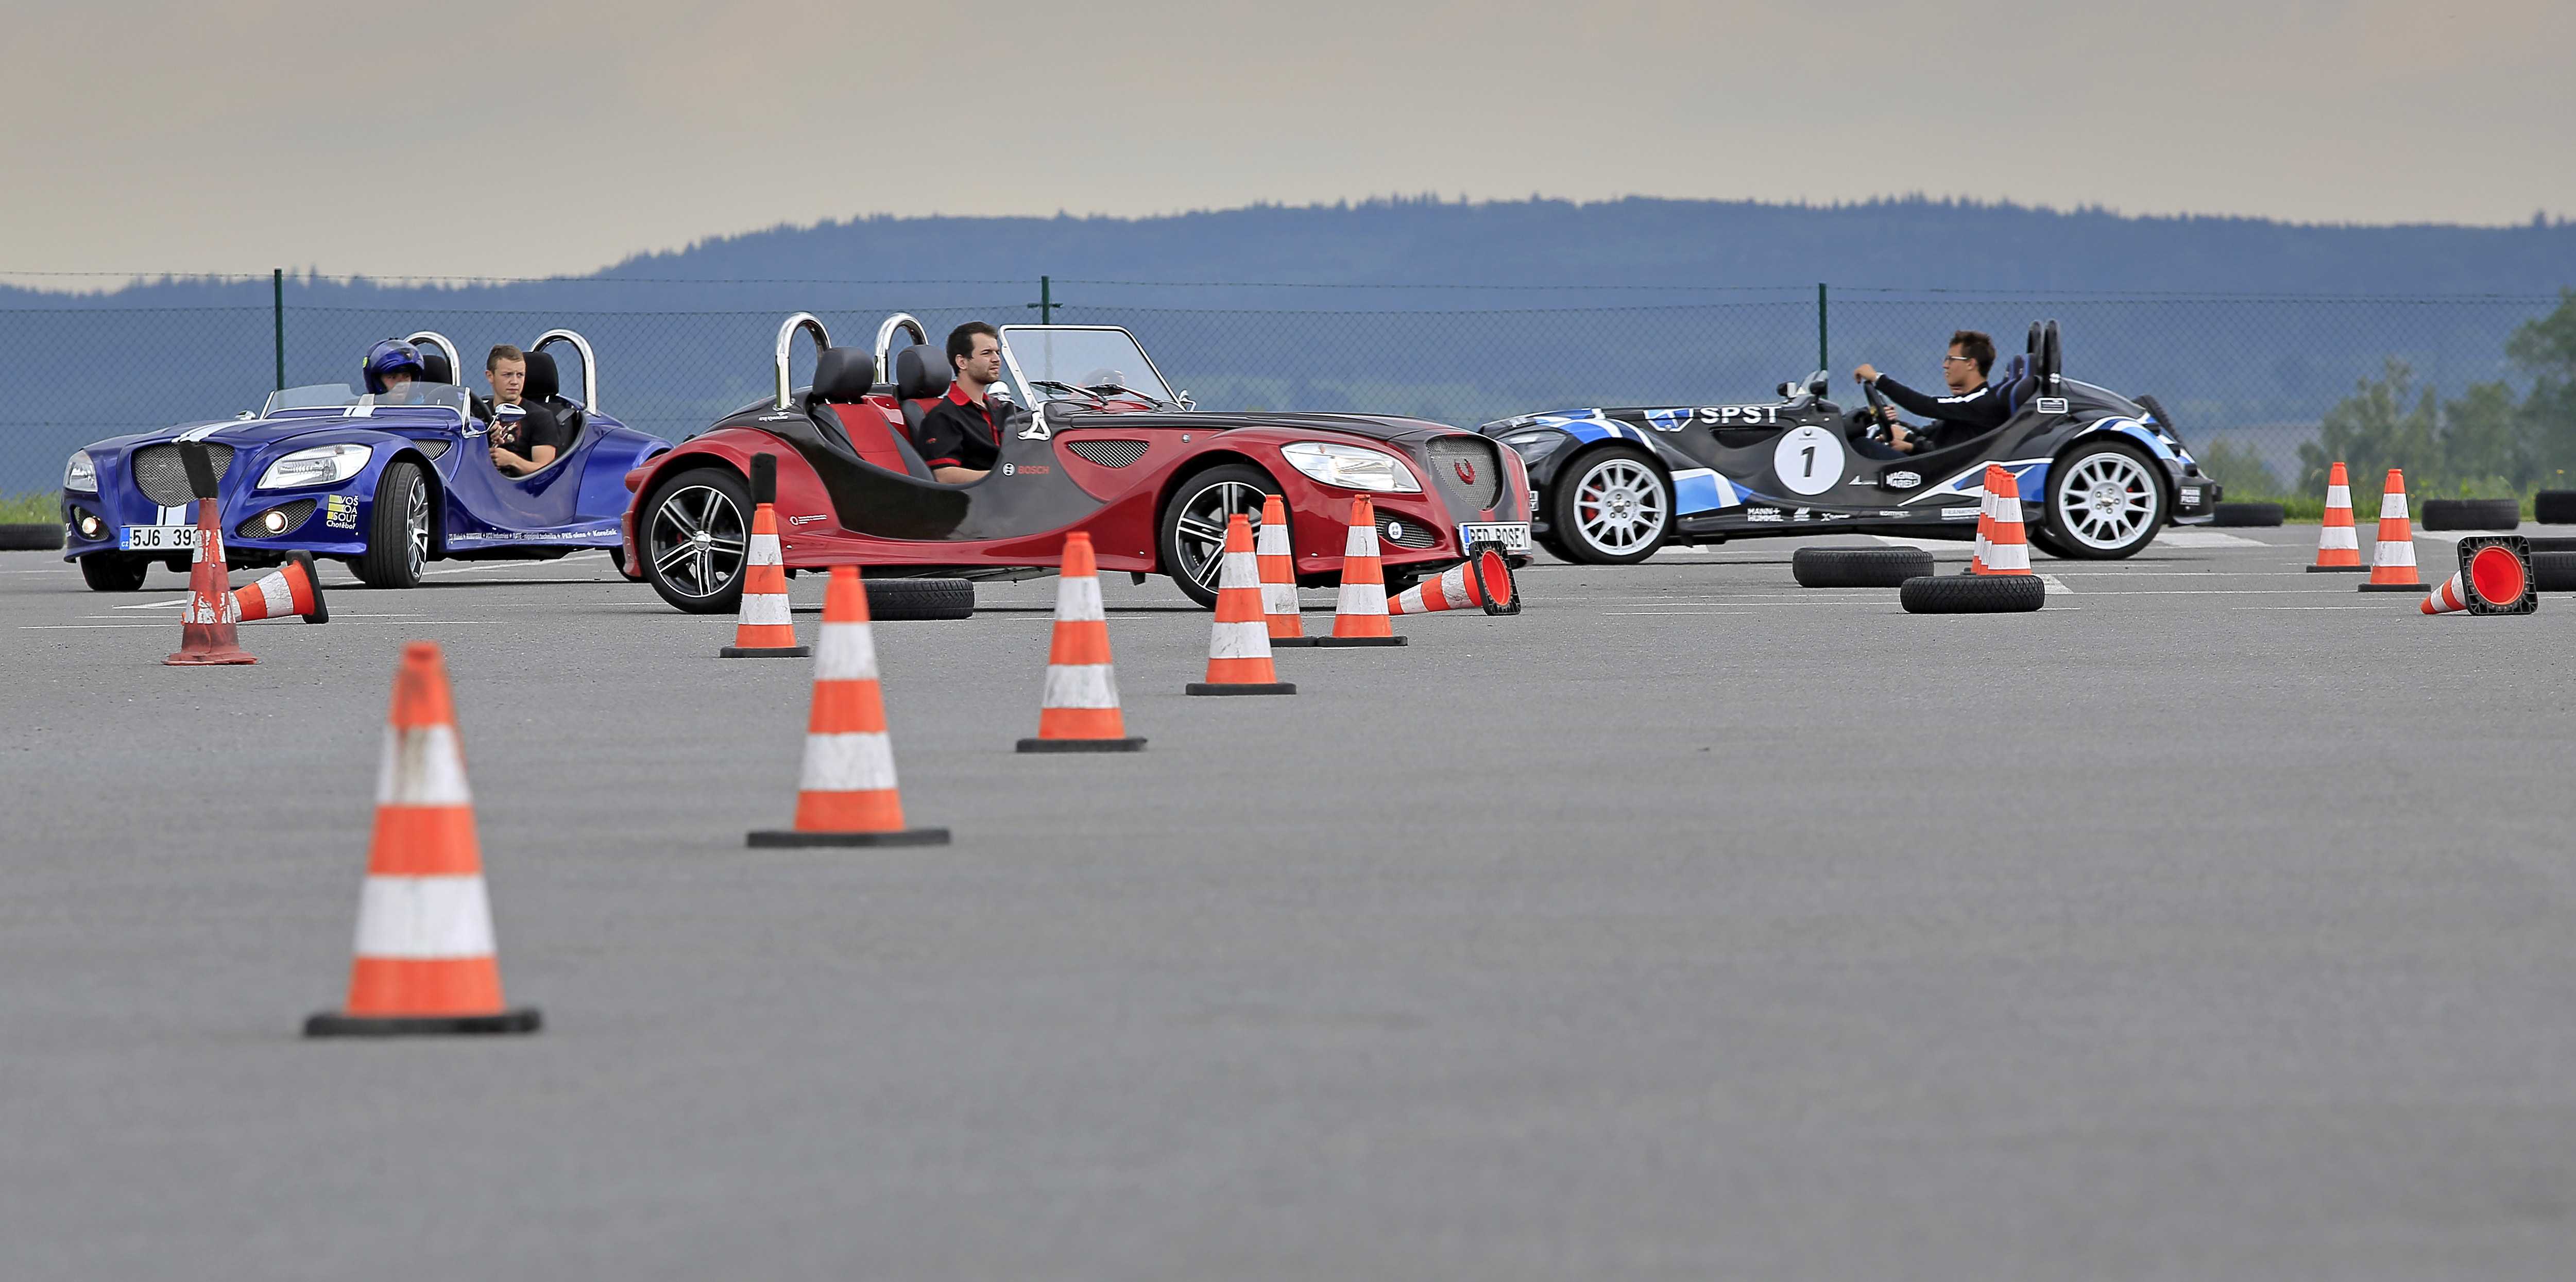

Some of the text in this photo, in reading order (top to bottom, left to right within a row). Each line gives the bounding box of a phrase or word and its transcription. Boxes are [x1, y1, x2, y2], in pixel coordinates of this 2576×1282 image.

[1699, 406, 1782, 424] SPST
[1801, 446, 1816, 478] 1
[1018, 466, 1050, 474] BOSCH
[339, 495, 359, 506] VOŠ
[344, 505, 357, 515] OA
[333, 512, 357, 523] SOUT
[326, 520, 356, 529] Chotěboř
[133, 529, 161, 546] 5J6
